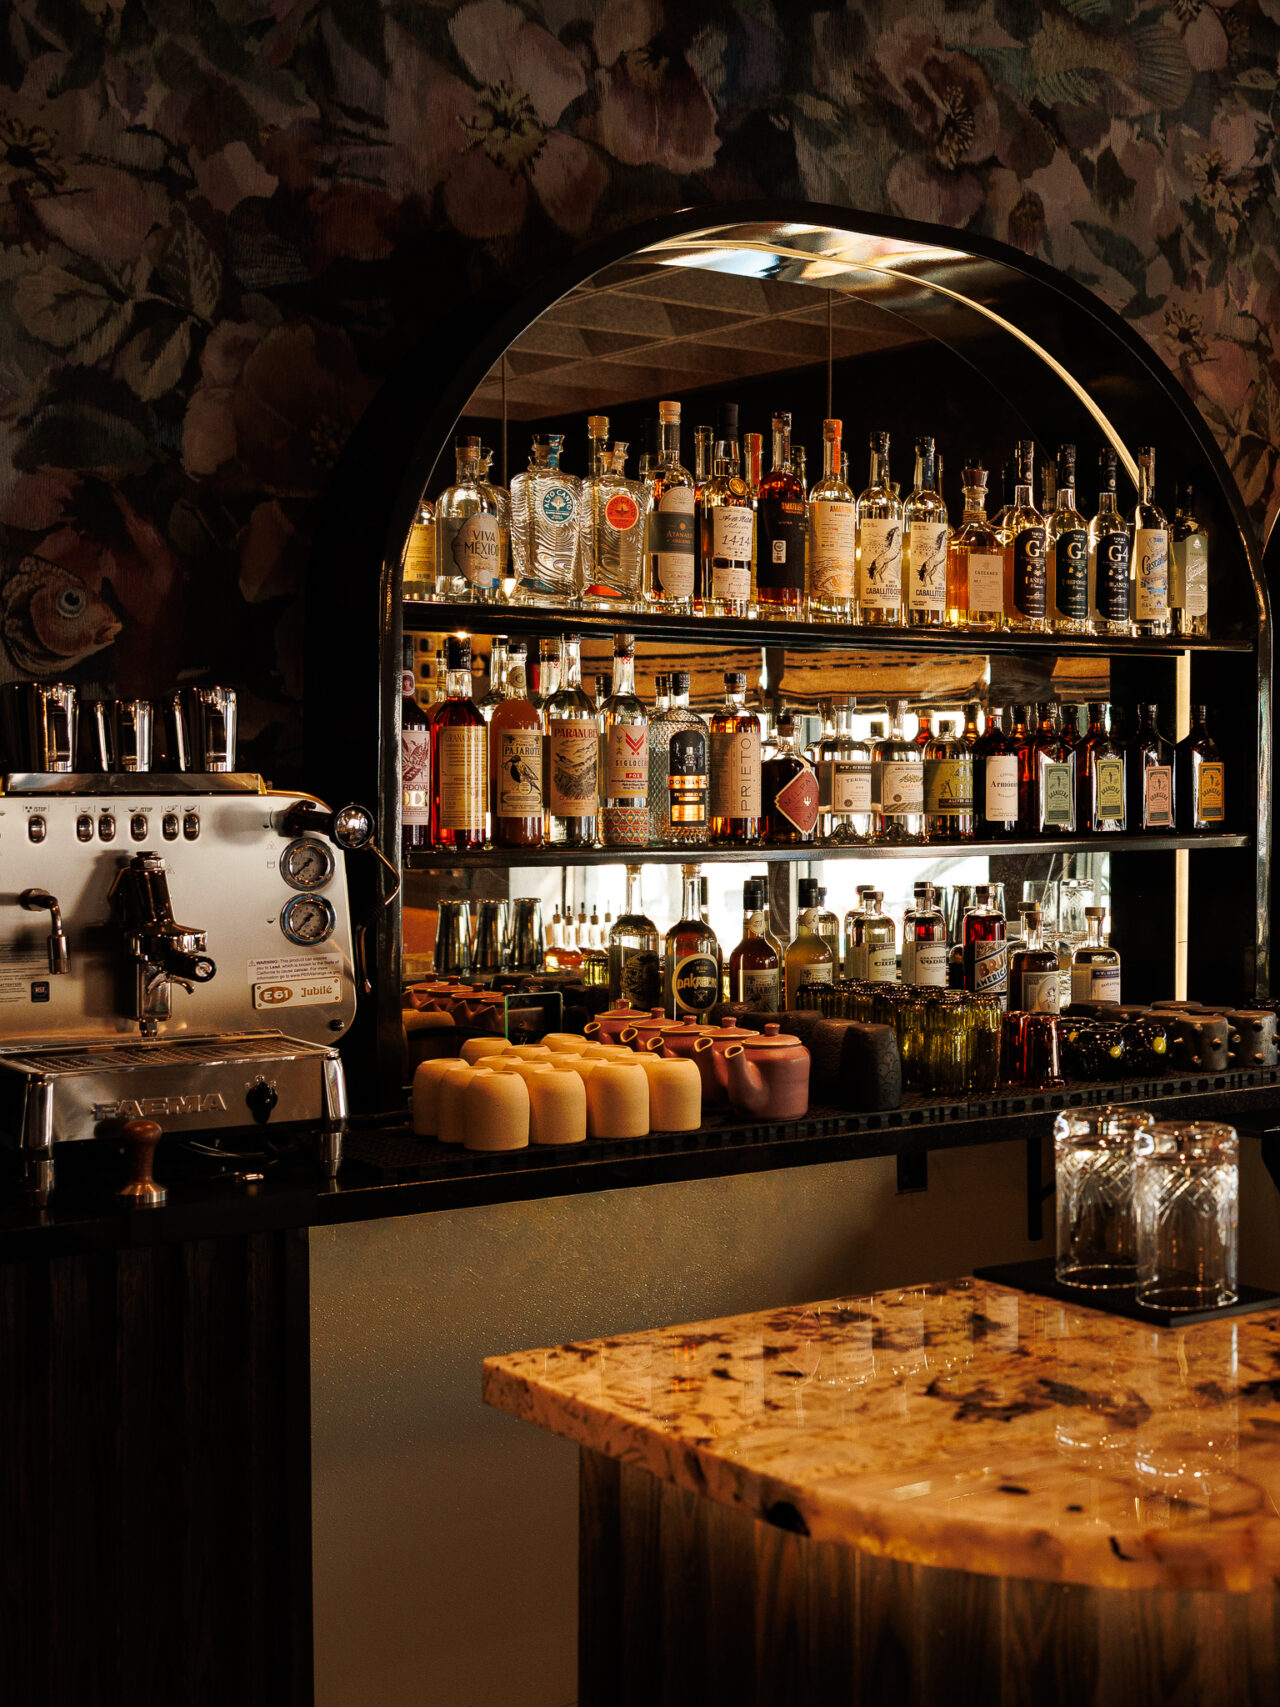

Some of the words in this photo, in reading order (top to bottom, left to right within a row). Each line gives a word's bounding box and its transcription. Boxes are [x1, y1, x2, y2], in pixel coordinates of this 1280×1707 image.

[473, 530, 496, 542] VIVA
[1025, 540, 1046, 558] G4
[1108, 545, 1129, 562] G4
[741, 738, 752, 811] PRIETO
[301, 985, 333, 998] Jubilé
[91, 1093, 227, 1120] FAEMA
